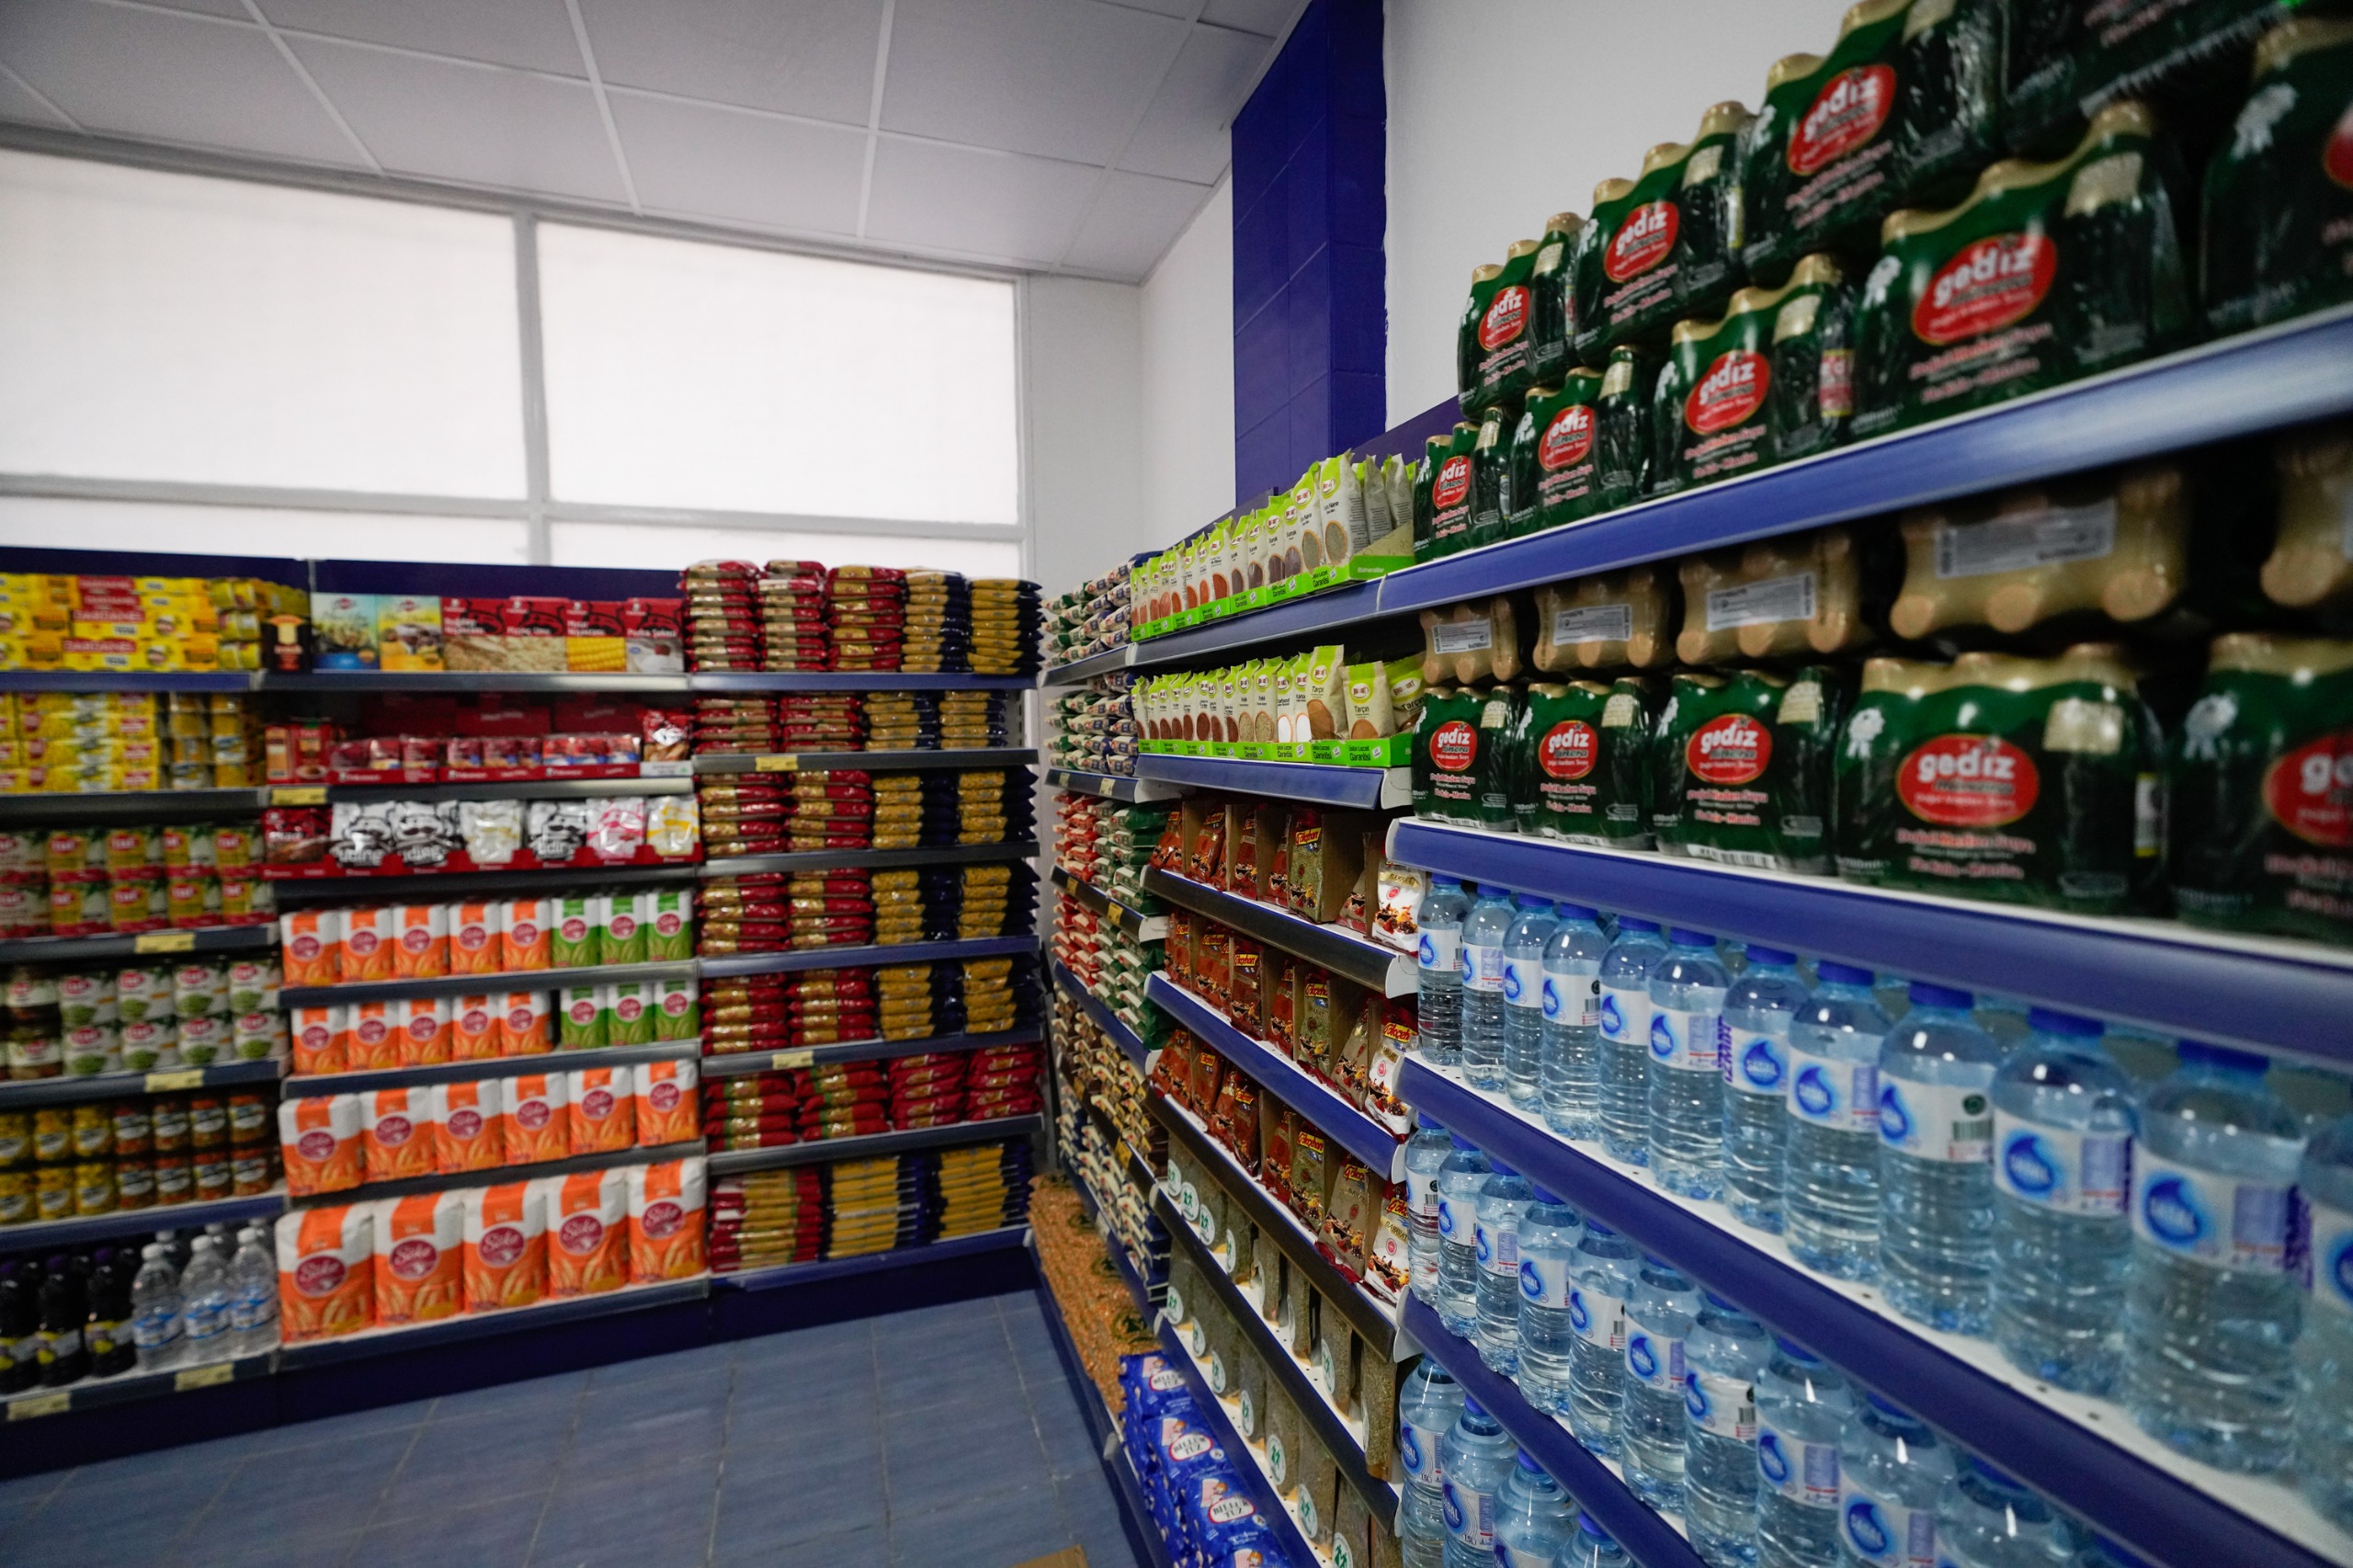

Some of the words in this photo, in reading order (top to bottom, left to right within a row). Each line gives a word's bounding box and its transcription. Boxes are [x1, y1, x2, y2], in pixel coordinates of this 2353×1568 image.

[1934, 247, 2033, 308] gediz
[1350, 753, 1370, 761] Garantisi
[1918, 748, 2015, 783] gediz
[644, 1208, 680, 1228] Söke
[563, 1221, 597, 1241] Söke
[483, 1233, 519, 1255] Söke
[1185, 1444, 1202, 1455] TUZ
[1224, 1506, 1244, 1518] TUZ
